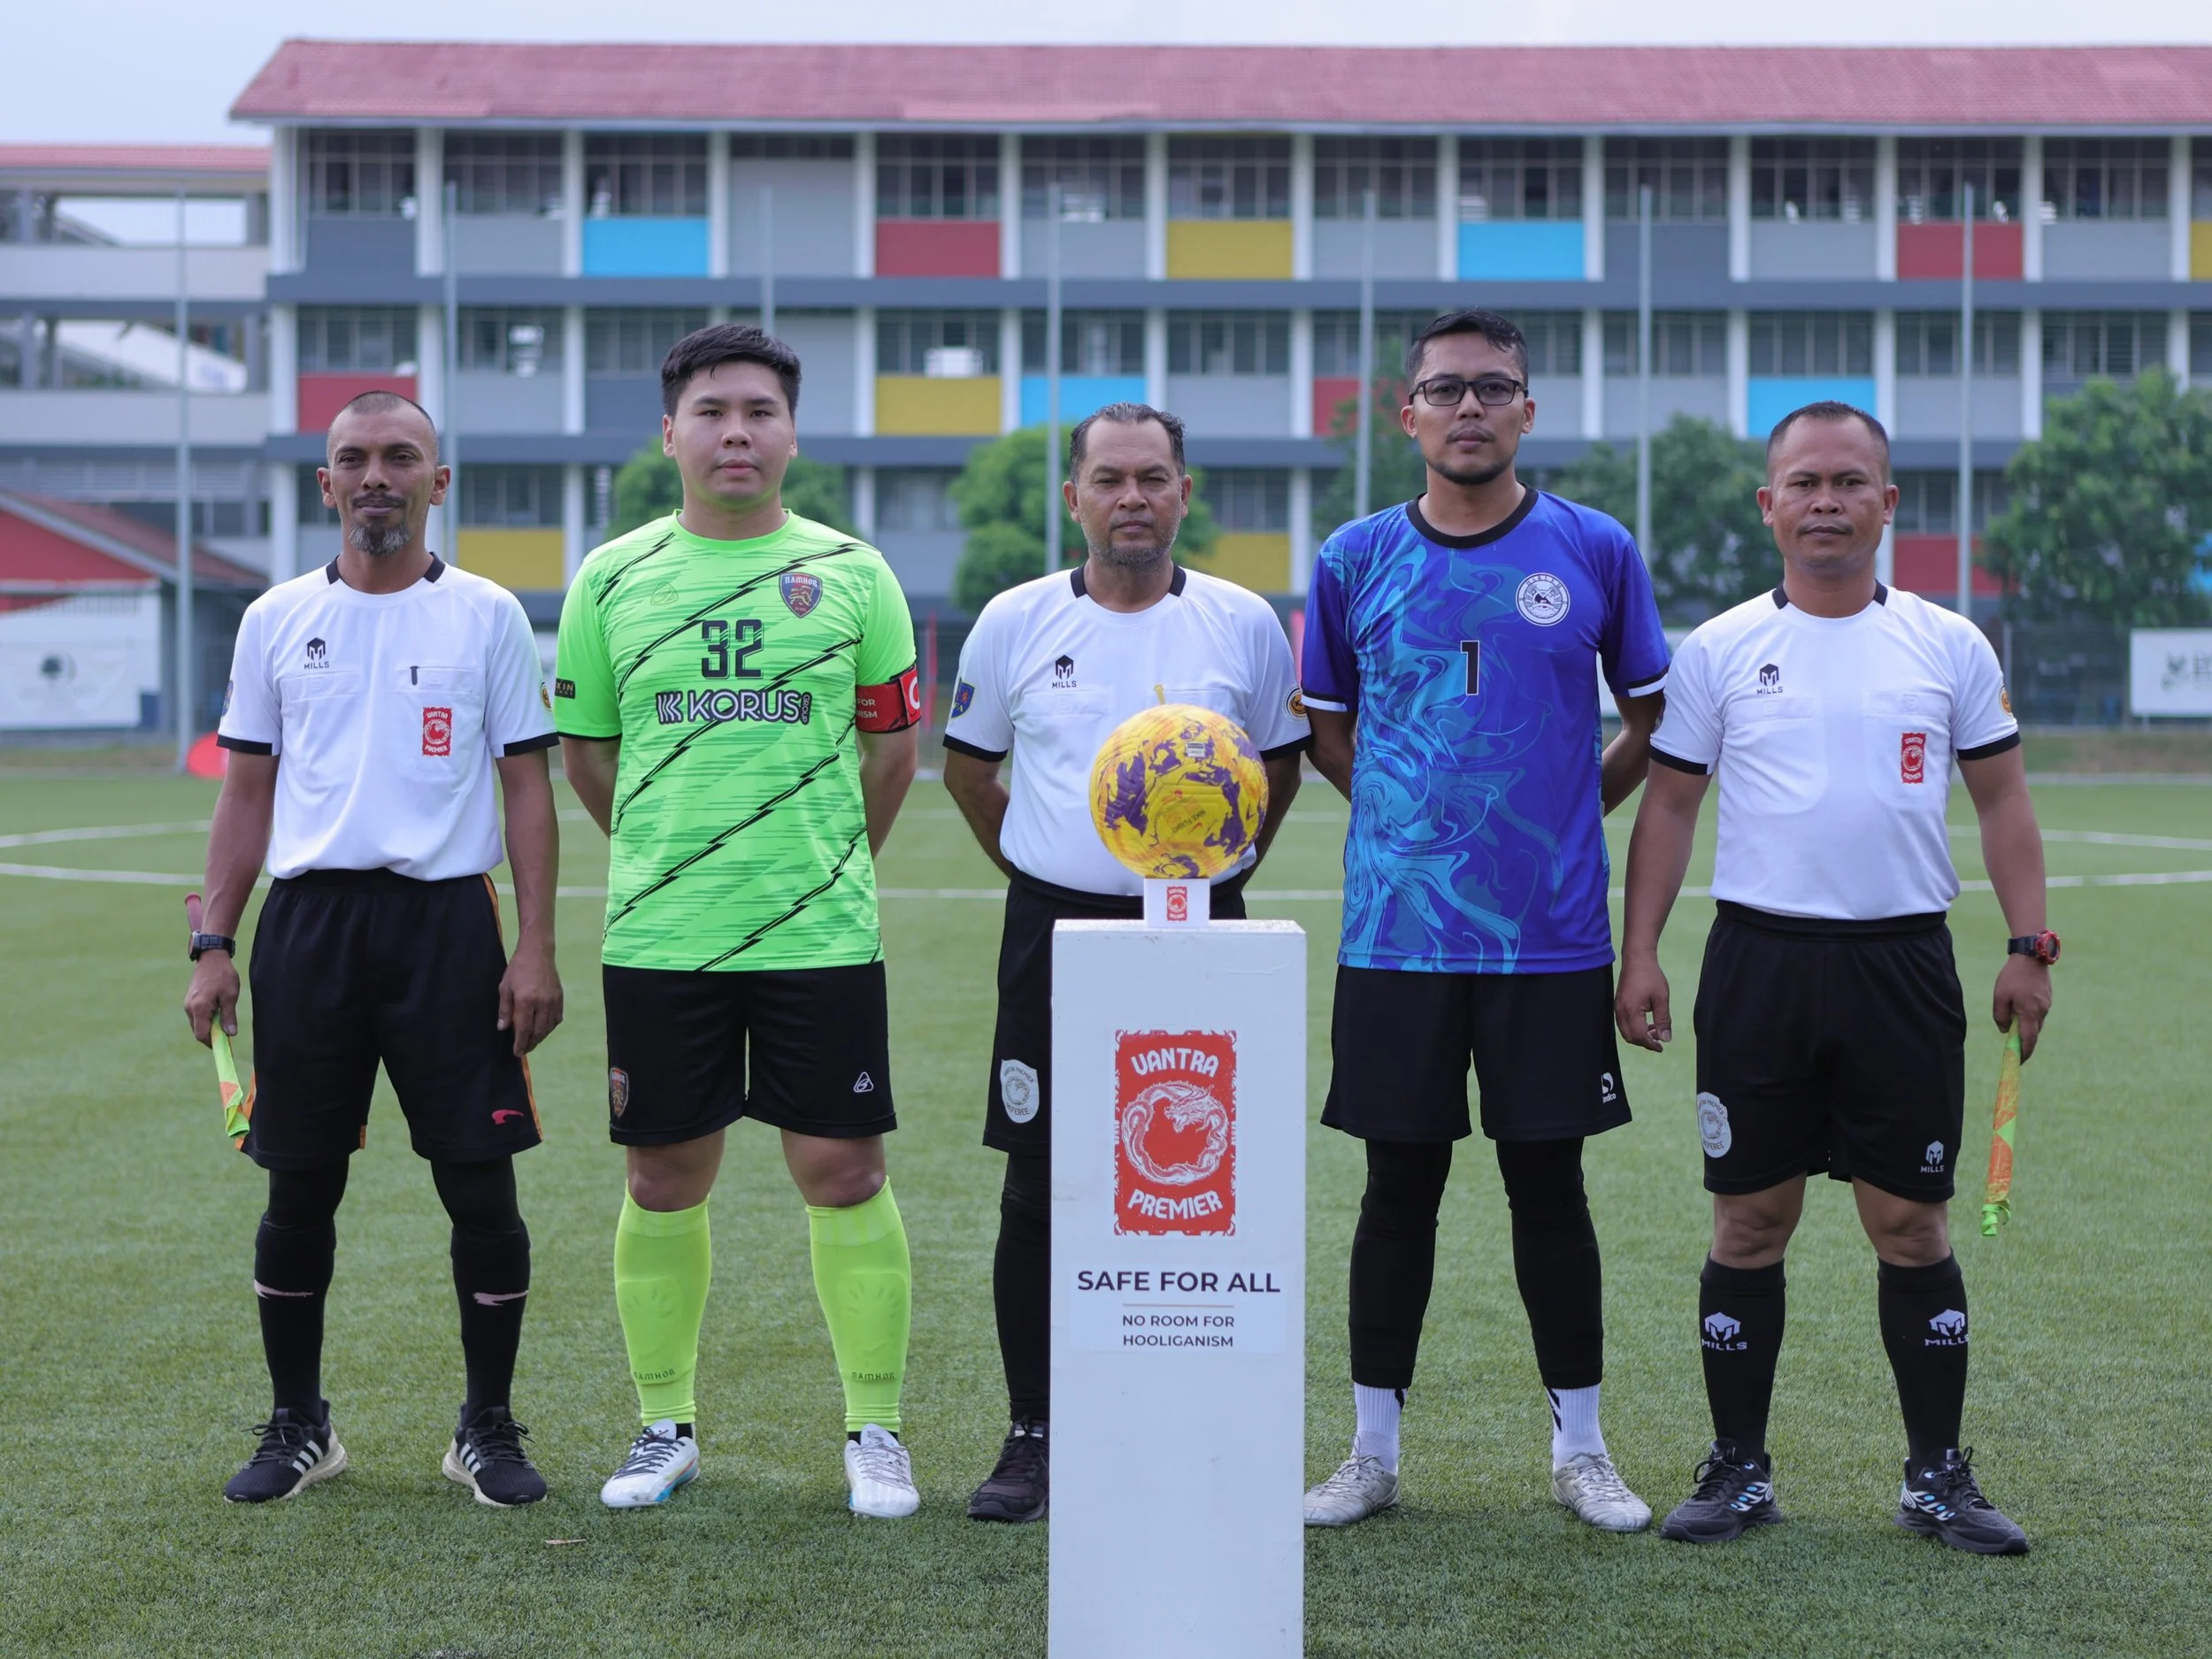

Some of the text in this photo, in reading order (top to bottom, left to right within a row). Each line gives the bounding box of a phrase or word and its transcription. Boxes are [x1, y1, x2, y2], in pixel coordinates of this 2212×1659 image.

[702, 619, 764, 680] 32
[303, 661, 330, 670] MILLS
[1460, 641, 1480, 695] 1
[688, 690, 801, 723] KORUS
[803, 694, 812, 724] GROUP
[1131, 1048, 1219, 1078] VANTRA
[1127, 1189, 1223, 1220] PREMIER
[1077, 1270, 1281, 1293] SAFE FOR ALL
[1122, 1315, 1235, 1327] NO ROOM FOR
[1123, 1334, 1233, 1347] HOOLIGANISM
[1701, 1338, 1747, 1351] MILLS
[1924, 1334, 1970, 1346] MILLS
